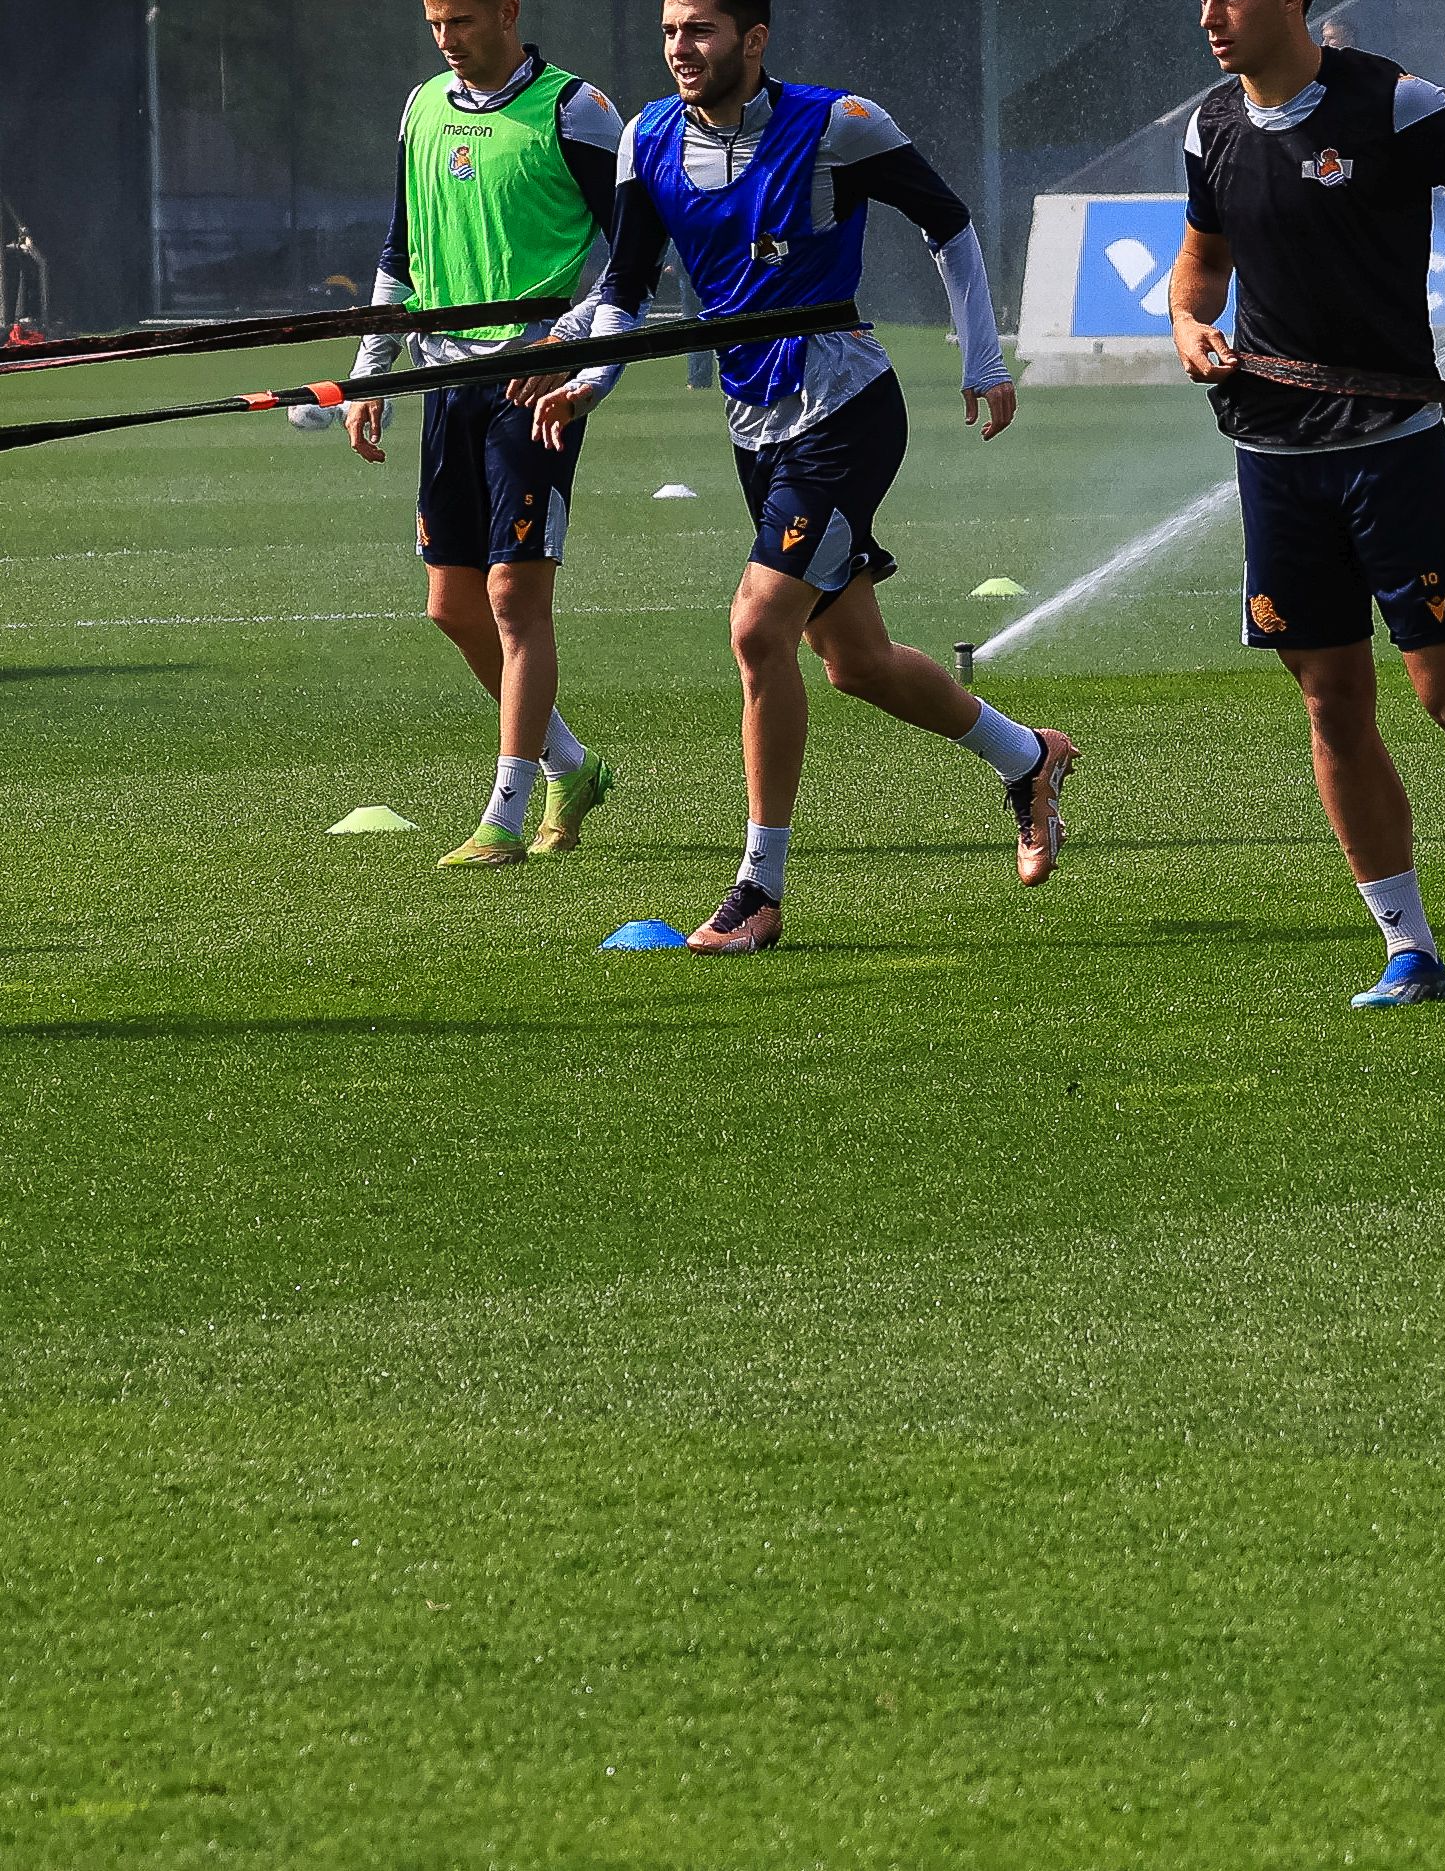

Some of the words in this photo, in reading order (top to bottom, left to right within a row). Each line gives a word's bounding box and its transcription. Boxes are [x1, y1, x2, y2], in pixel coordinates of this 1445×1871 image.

[443, 124, 493, 138] macron
[524, 494, 534, 505] 5
[793, 515, 808, 529] 12
[1420, 572, 1438, 586] 10
